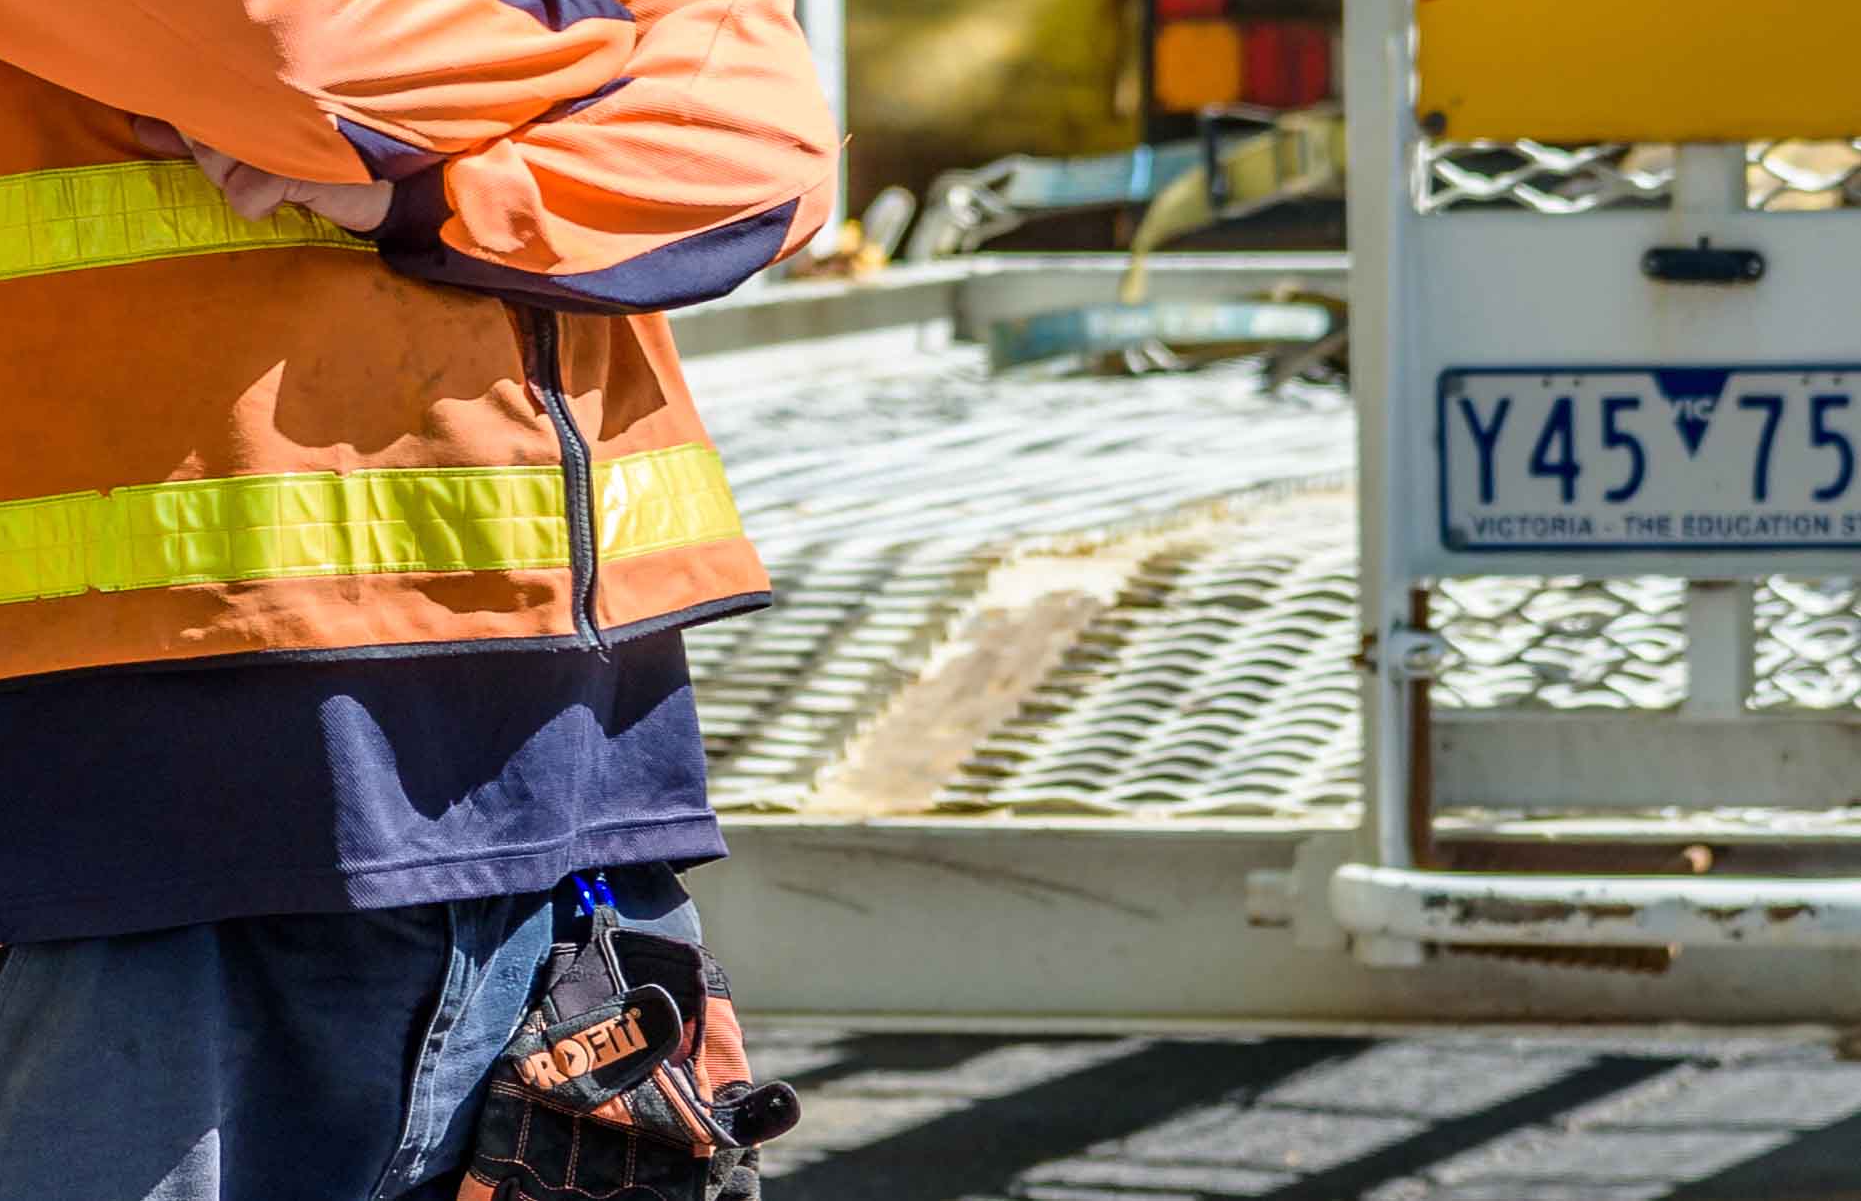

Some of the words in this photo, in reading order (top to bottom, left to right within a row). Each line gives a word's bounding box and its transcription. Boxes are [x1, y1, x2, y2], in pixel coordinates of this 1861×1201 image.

[1671, 399, 1717, 422] VIC
[1459, 396, 1646, 504] Y45
[1473, 515, 1592, 537] VICTORIA
[1624, 515, 1671, 536] THE
[1683, 514, 1831, 537] EDUCATION
